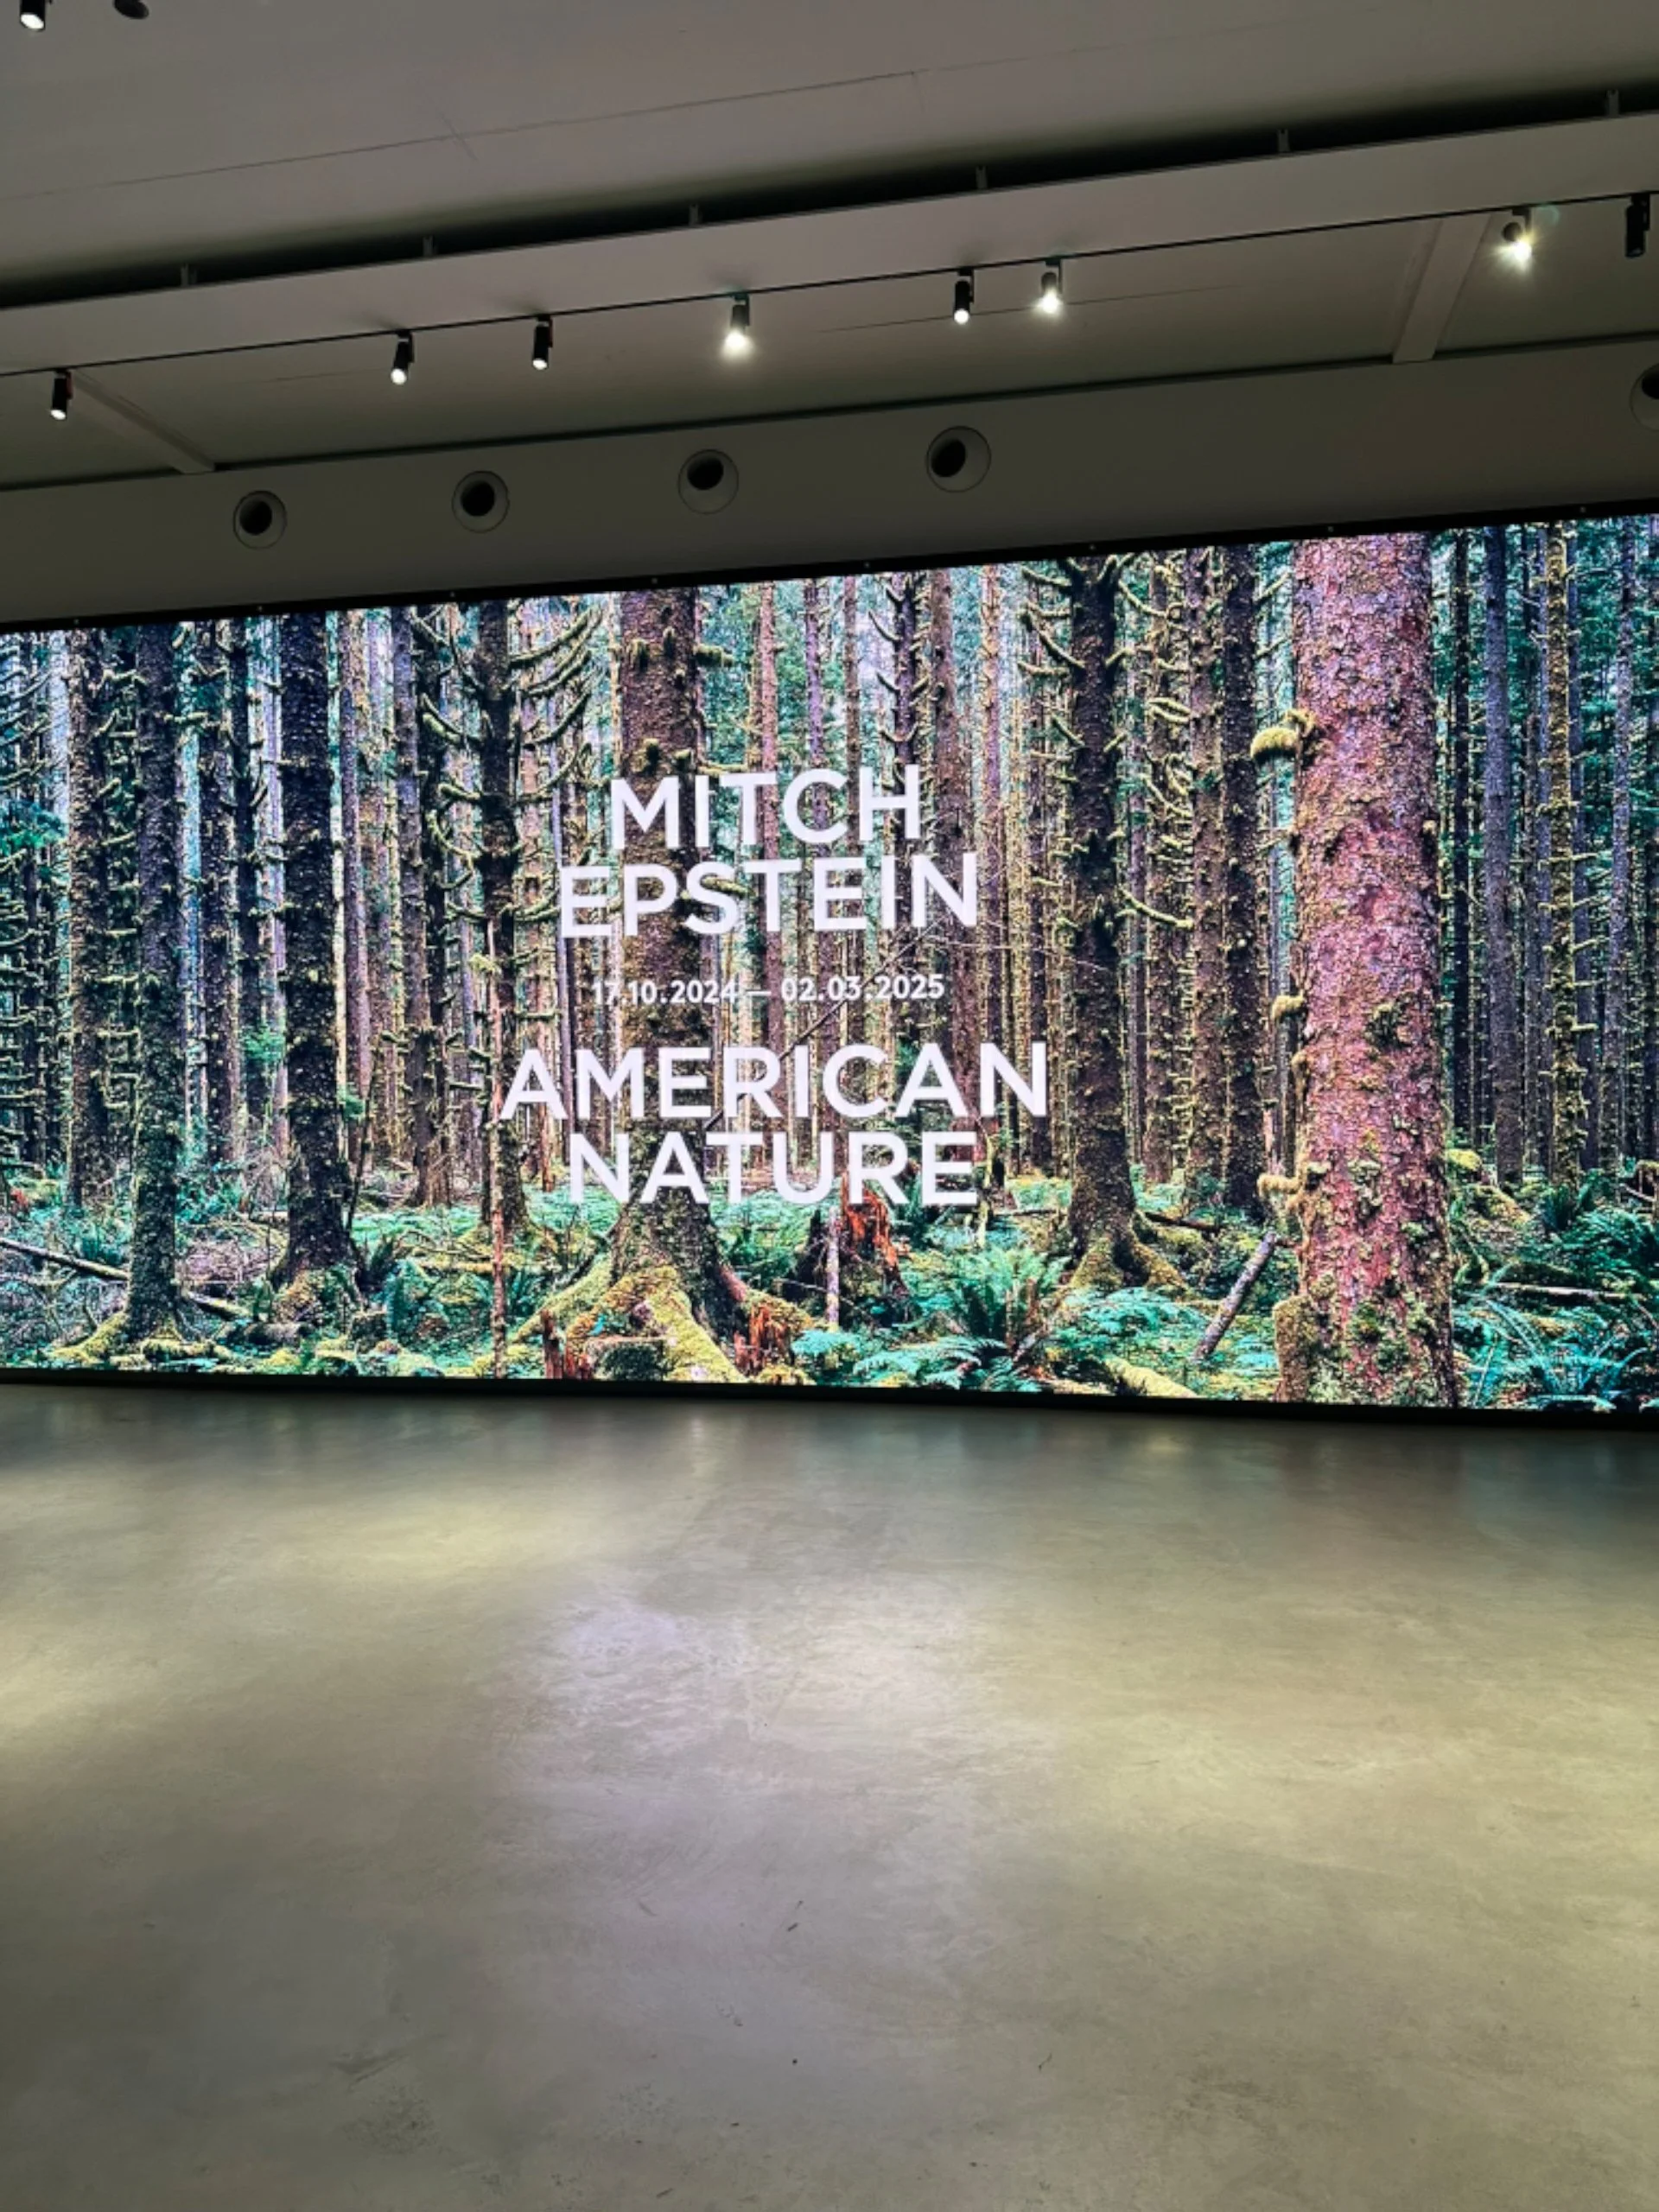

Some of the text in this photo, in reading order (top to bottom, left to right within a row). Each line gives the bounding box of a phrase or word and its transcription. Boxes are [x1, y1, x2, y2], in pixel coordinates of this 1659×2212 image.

[611, 764, 921, 849] MITCH
[560, 852, 977, 938] EPSTEIN
[592, 979, 738, 1006] 17.10.2024
[781, 974, 945, 1001] 02.03.2025
[501, 1041, 1048, 1121] AMERICAN
[569, 1130, 978, 1206] NATURE
